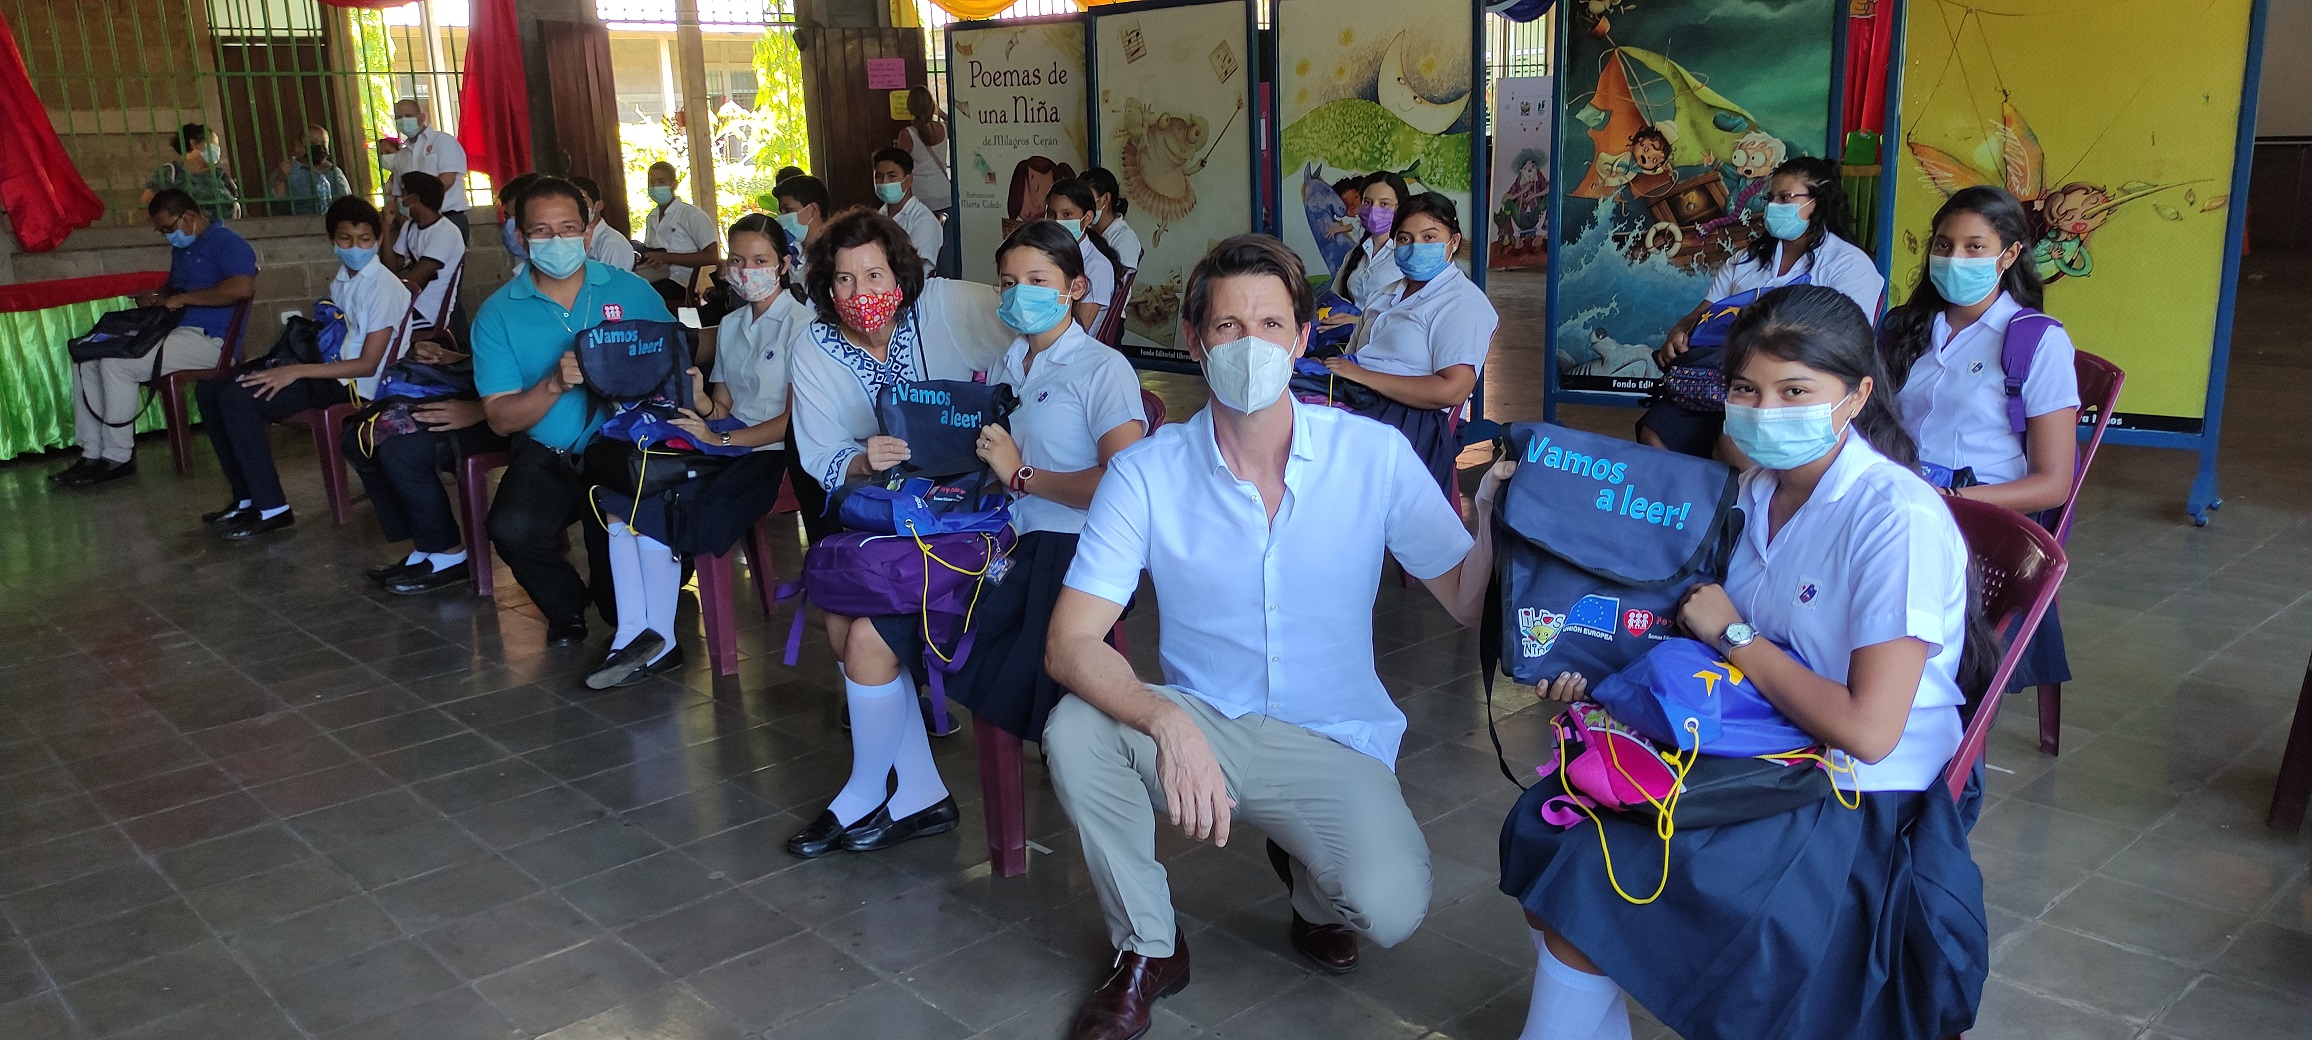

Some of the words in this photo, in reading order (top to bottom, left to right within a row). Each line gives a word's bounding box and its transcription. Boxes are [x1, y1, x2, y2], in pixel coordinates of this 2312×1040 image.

[969, 60, 1041, 88] Poemas
[1048, 61, 1068, 85] de
[978, 109, 1008, 124] una
[1013, 96, 1060, 124] Niña
[982, 136, 992, 146] de
[993, 135, 1030, 149] Milagros
[588, 328, 638, 349] ¡Vamos
[629, 343, 637, 357] a
[638, 337, 664, 355] leer!
[1140, 348, 1155, 357] Fondo
[1155, 349, 1176, 359] Editorial
[892, 383, 951, 407] ¡Vamos
[1612, 379, 1637, 389] Fondo
[941, 409, 948, 425] a
[950, 405, 982, 428] leer!
[1527, 434, 1628, 484] Vamos
[1596, 488, 1615, 512] a
[1619, 484, 1692, 531] leer!
[1583, 627, 1614, 642] EUROPEA
